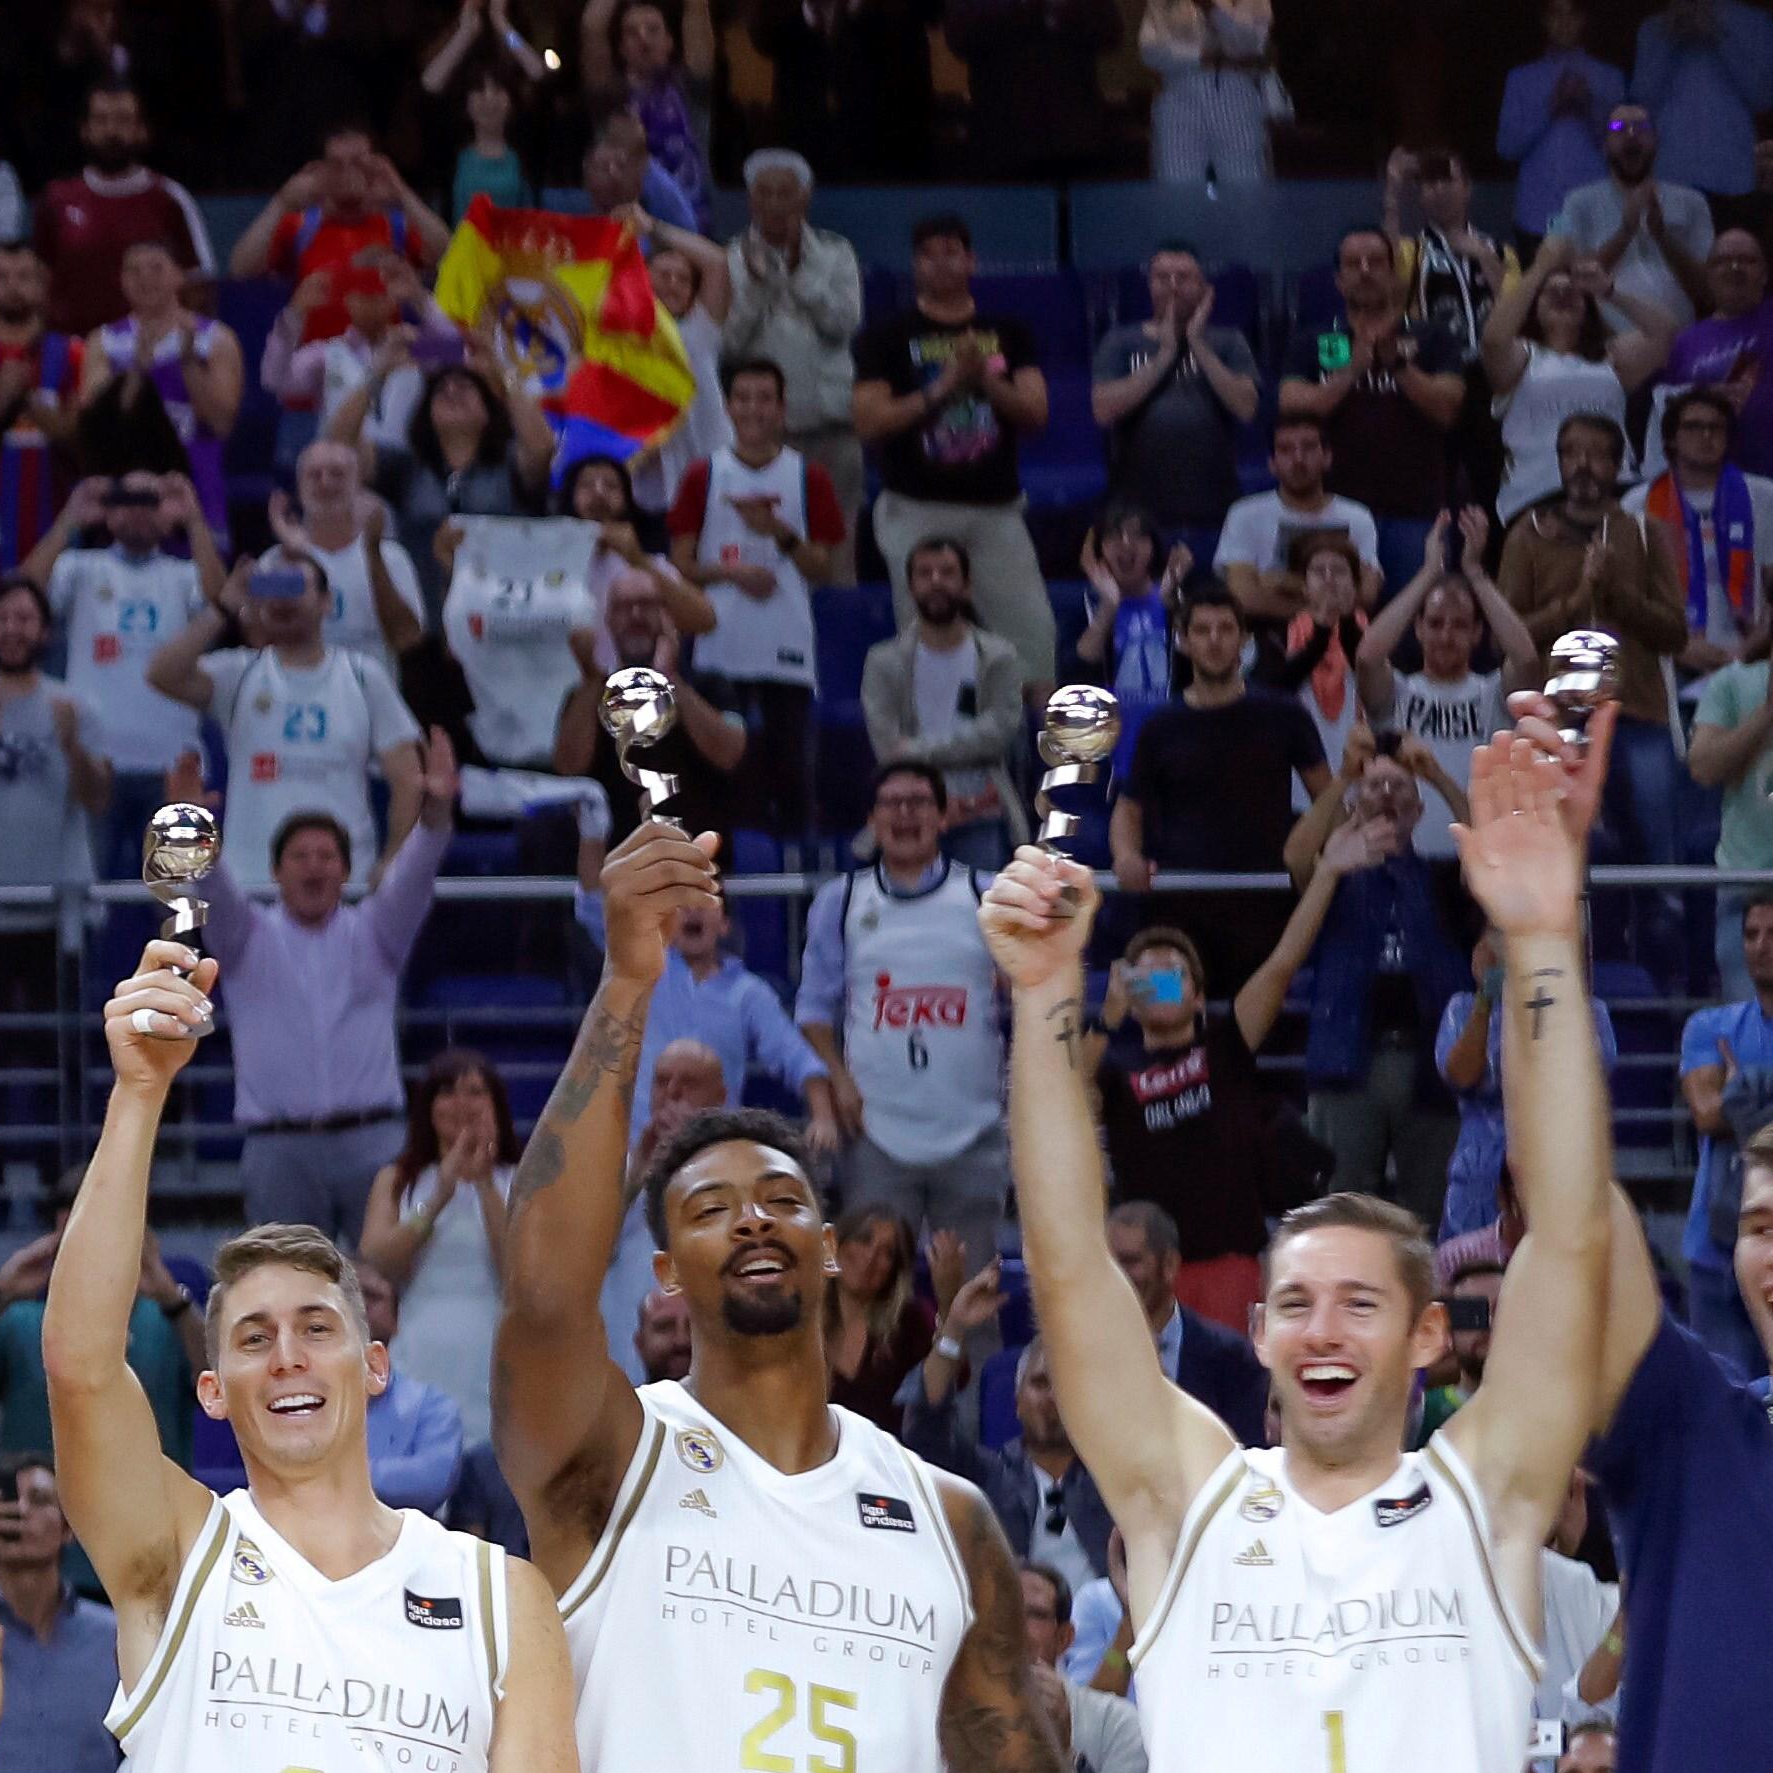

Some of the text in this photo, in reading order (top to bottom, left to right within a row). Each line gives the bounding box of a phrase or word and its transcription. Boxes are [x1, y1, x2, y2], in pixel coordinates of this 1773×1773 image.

[282, 701, 329, 741] 23
[906, 1033, 929, 1071] 6
[665, 1544, 936, 1642] PALLADIUM
[1211, 1587, 1467, 1644] PALLADIUM
[661, 1604, 934, 1677] HOTEL GROUP
[204, 1710, 323, 1739] HOTEL
[209, 1650, 470, 1744] PALLADIUM
